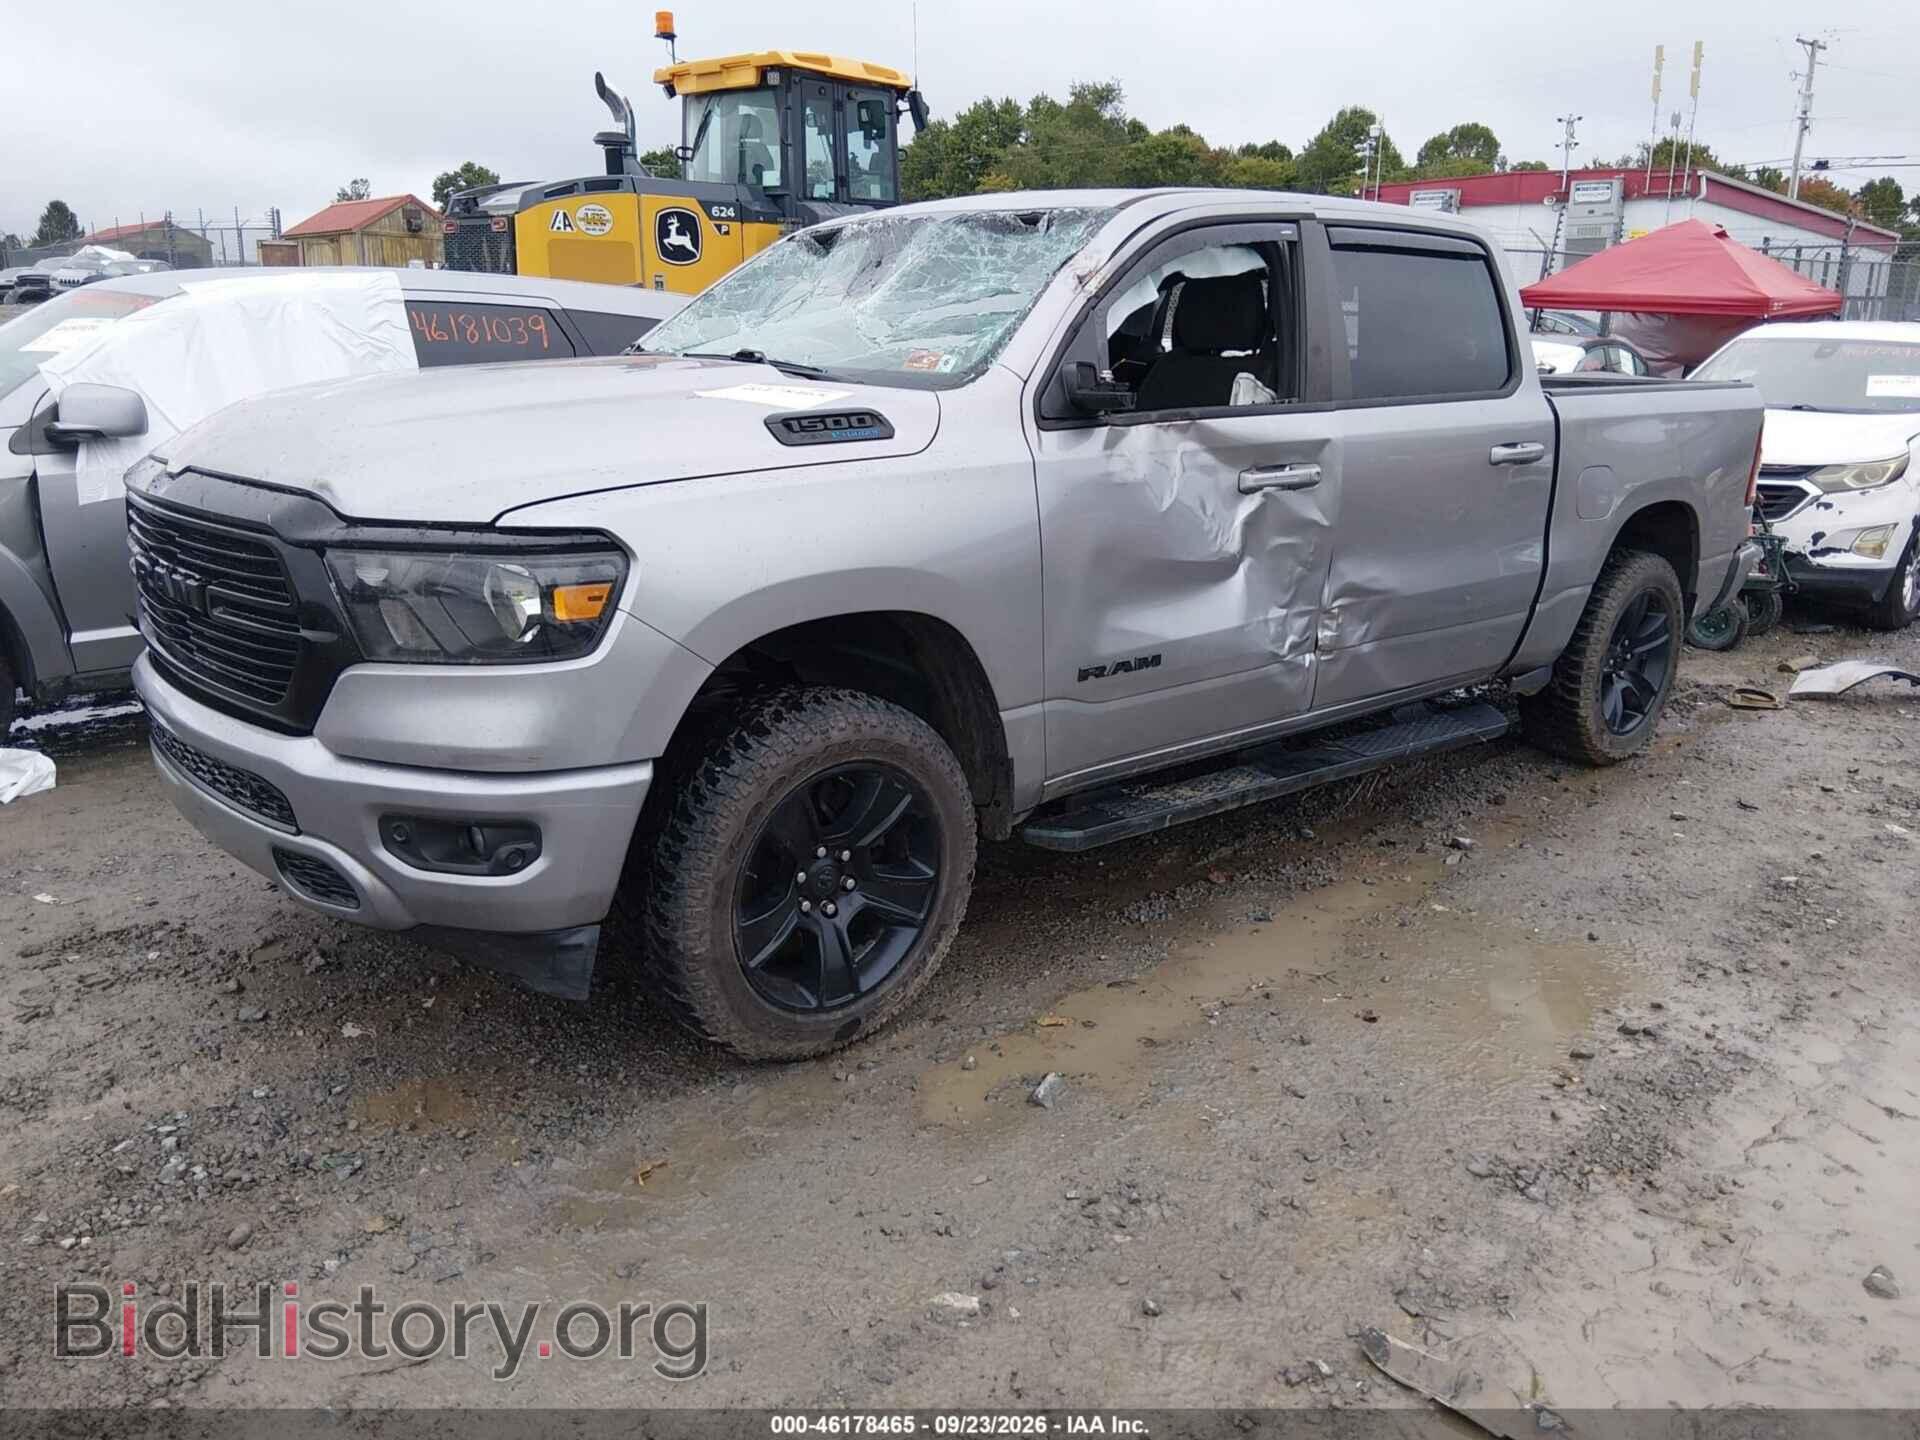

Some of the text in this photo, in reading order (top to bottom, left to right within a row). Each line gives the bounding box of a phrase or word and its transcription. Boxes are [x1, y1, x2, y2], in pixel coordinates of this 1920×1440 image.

[711, 205, 736, 218] 624
[720, 224, 730, 235] P
[411, 311, 549, 351] 46181039
[782, 414, 874, 433] 1500
[1077, 654, 1162, 682] RAM
